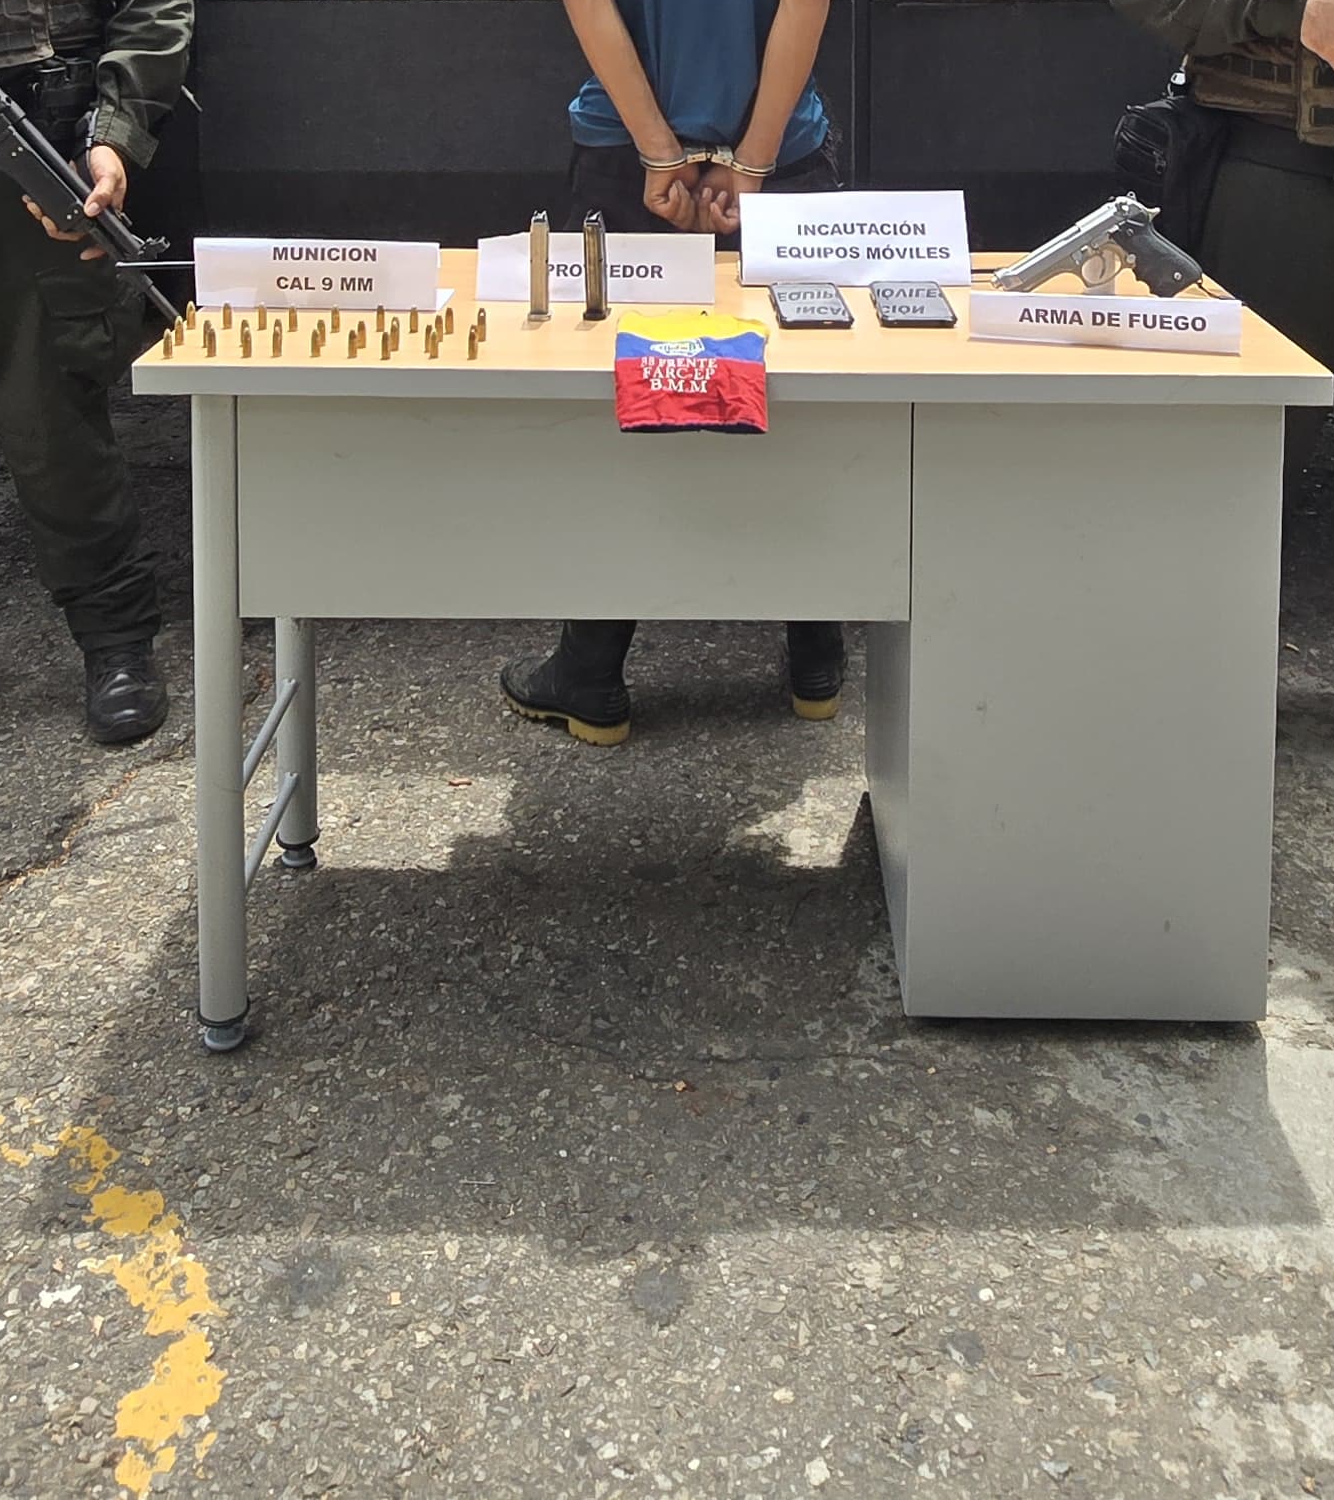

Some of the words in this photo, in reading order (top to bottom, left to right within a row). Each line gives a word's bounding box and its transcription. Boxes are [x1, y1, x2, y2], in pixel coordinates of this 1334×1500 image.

[797, 220, 927, 236] INCAUTACIÓN
[273, 247, 377, 262] MUNICION
[776, 245, 861, 259] EQUIPOS
[866, 243, 951, 260] MÓVILES
[548, 263, 664, 279] PROEDOR
[276, 276, 316, 291] CAL
[321, 277, 333, 291] 9
[340, 277, 373, 292] MM
[1018, 307, 1084, 326] ARMA
[1091, 311, 1121, 328] DE
[1128, 313, 1207, 332] FUEGO
[658, 357, 718, 368] FRENTE
